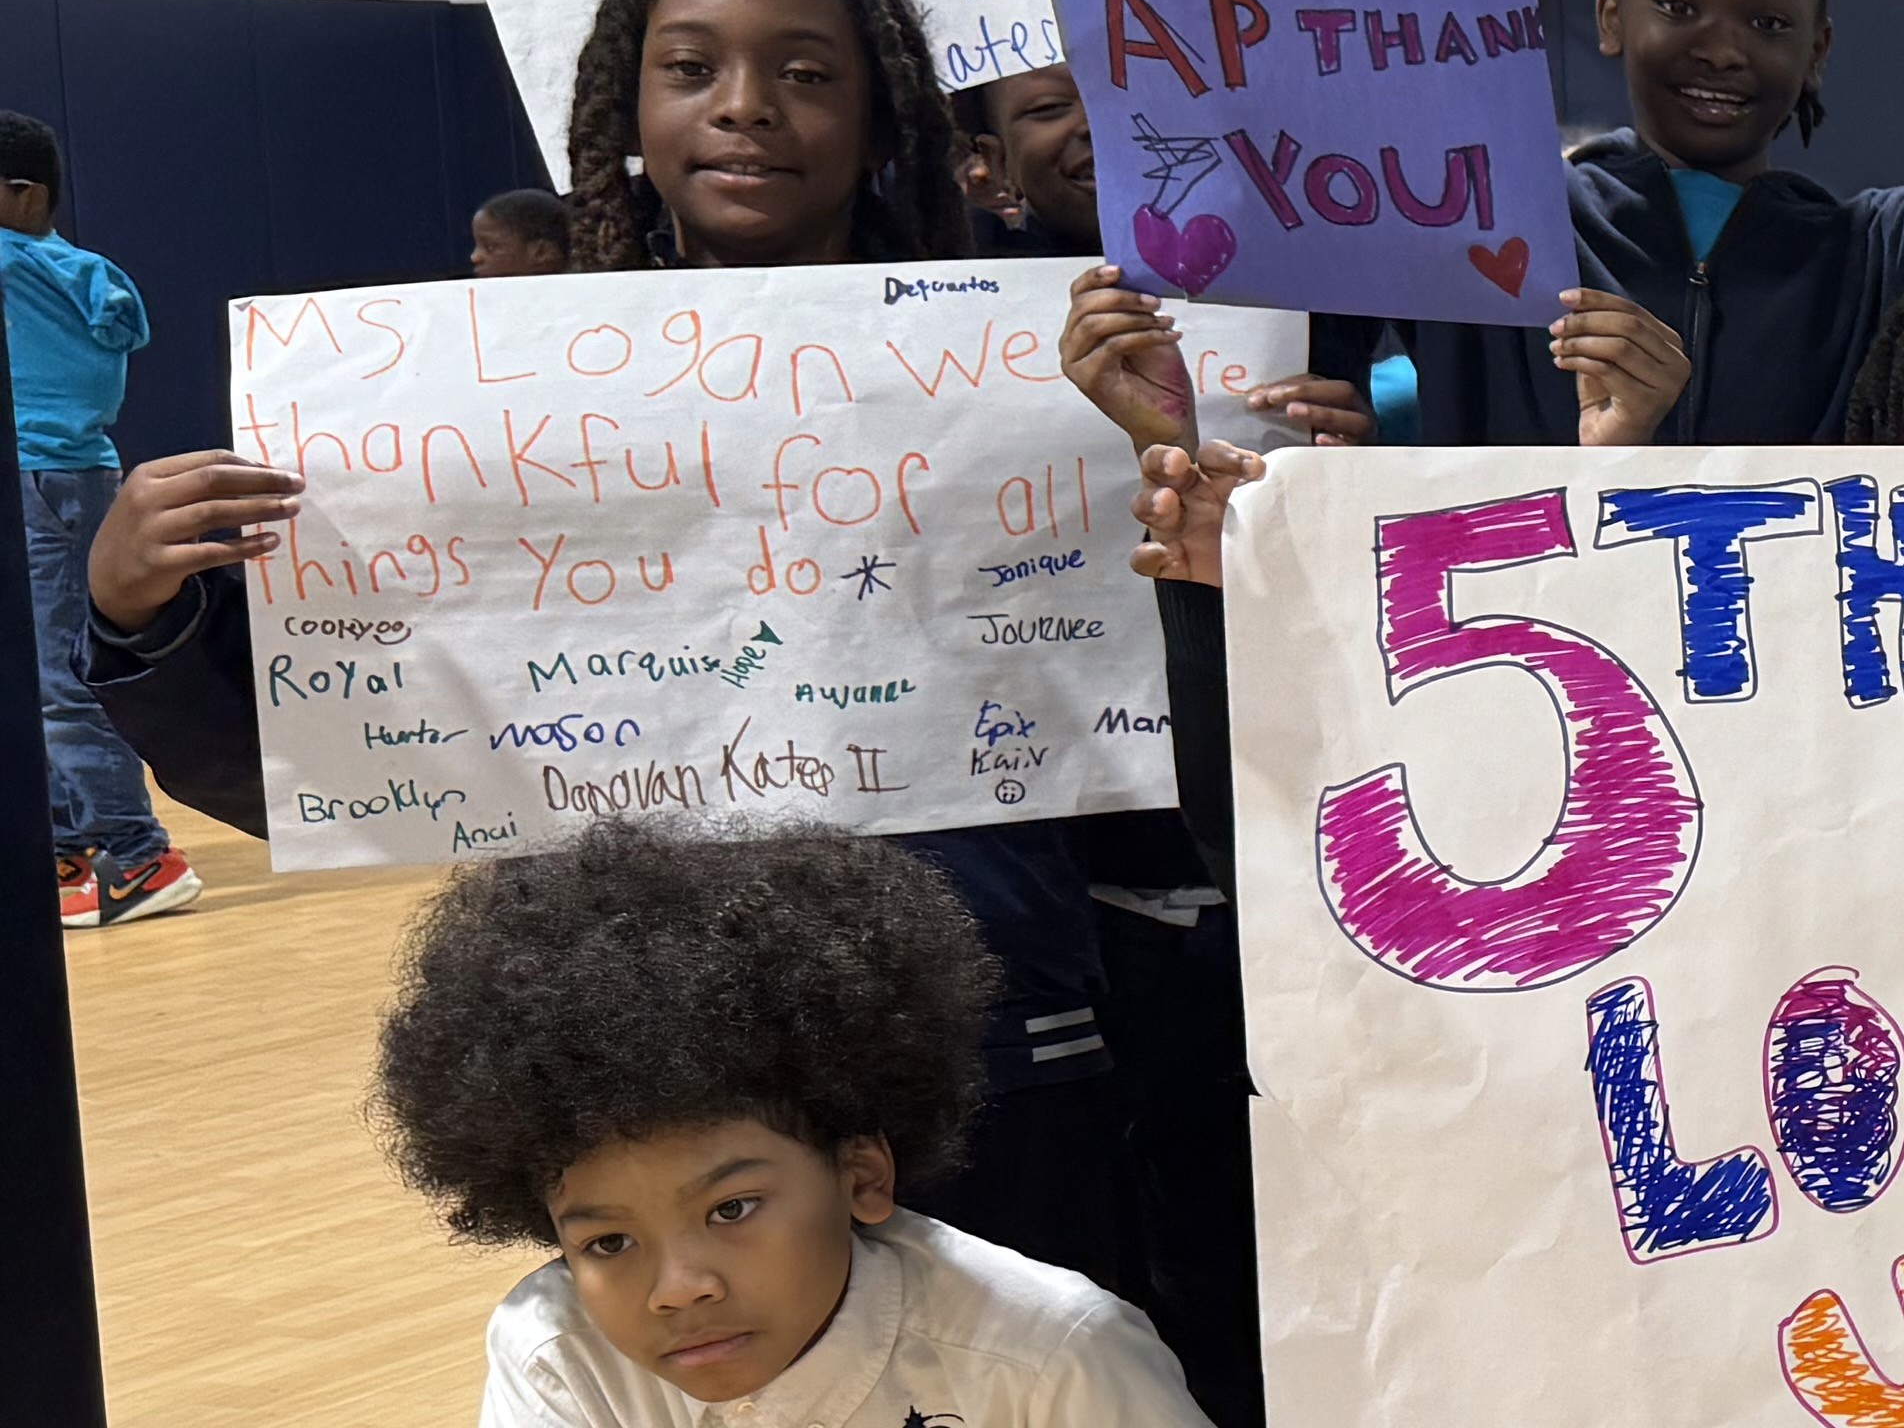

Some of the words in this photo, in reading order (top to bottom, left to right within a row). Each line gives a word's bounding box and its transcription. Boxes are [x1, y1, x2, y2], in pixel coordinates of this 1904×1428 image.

[937, 14, 1056, 93] ates
[468, 289, 854, 416] Logan
[1197, 349, 1247, 394] re
[239, 393, 720, 509] thankful
[761, 434, 929, 535] for
[997, 457, 1089, 538] all
[247, 518, 471, 607] things
[747, 526, 821, 595] do
[269, 654, 404, 706] Royal
[721, 645, 767, 689] Hope
[298, 779, 466, 824] Brooklyn
